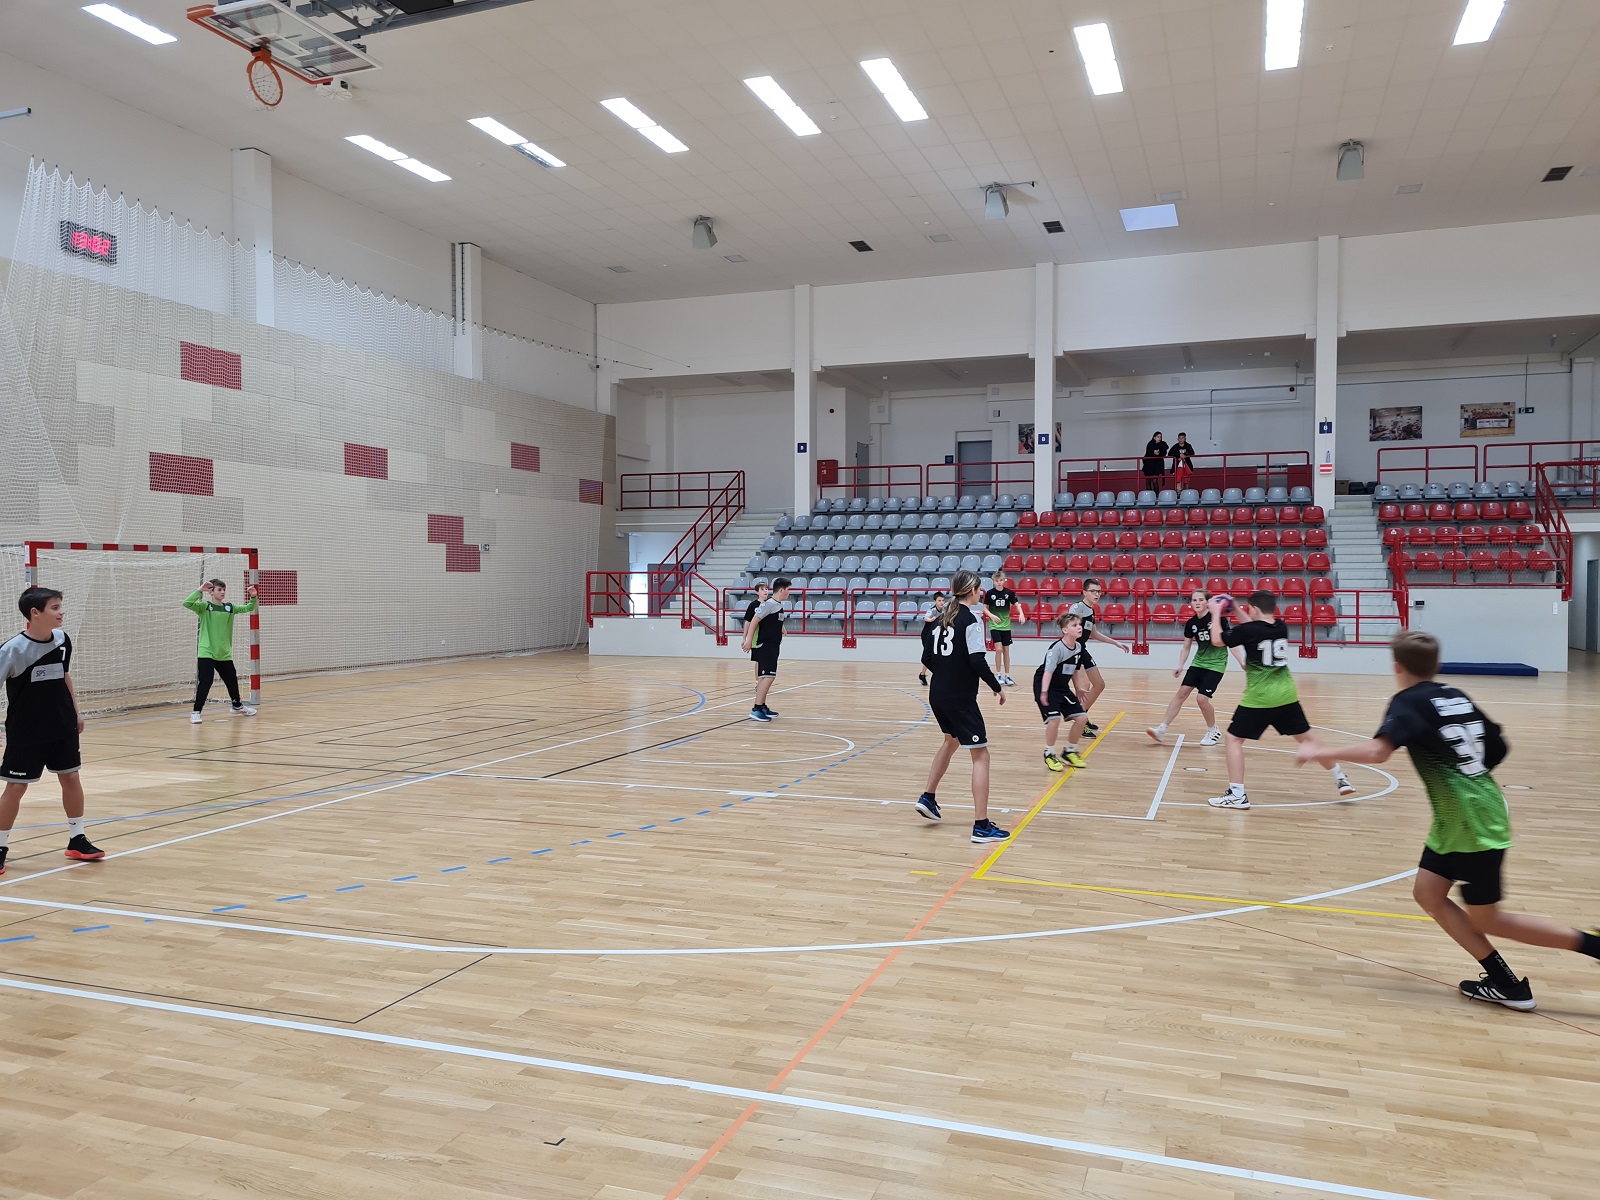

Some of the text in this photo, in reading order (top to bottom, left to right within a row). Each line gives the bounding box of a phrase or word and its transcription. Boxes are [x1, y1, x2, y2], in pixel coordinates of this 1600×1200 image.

[60, 646, 66, 661] 7
[931, 625, 955, 657] 13
[1257, 638, 1288, 667] 19
